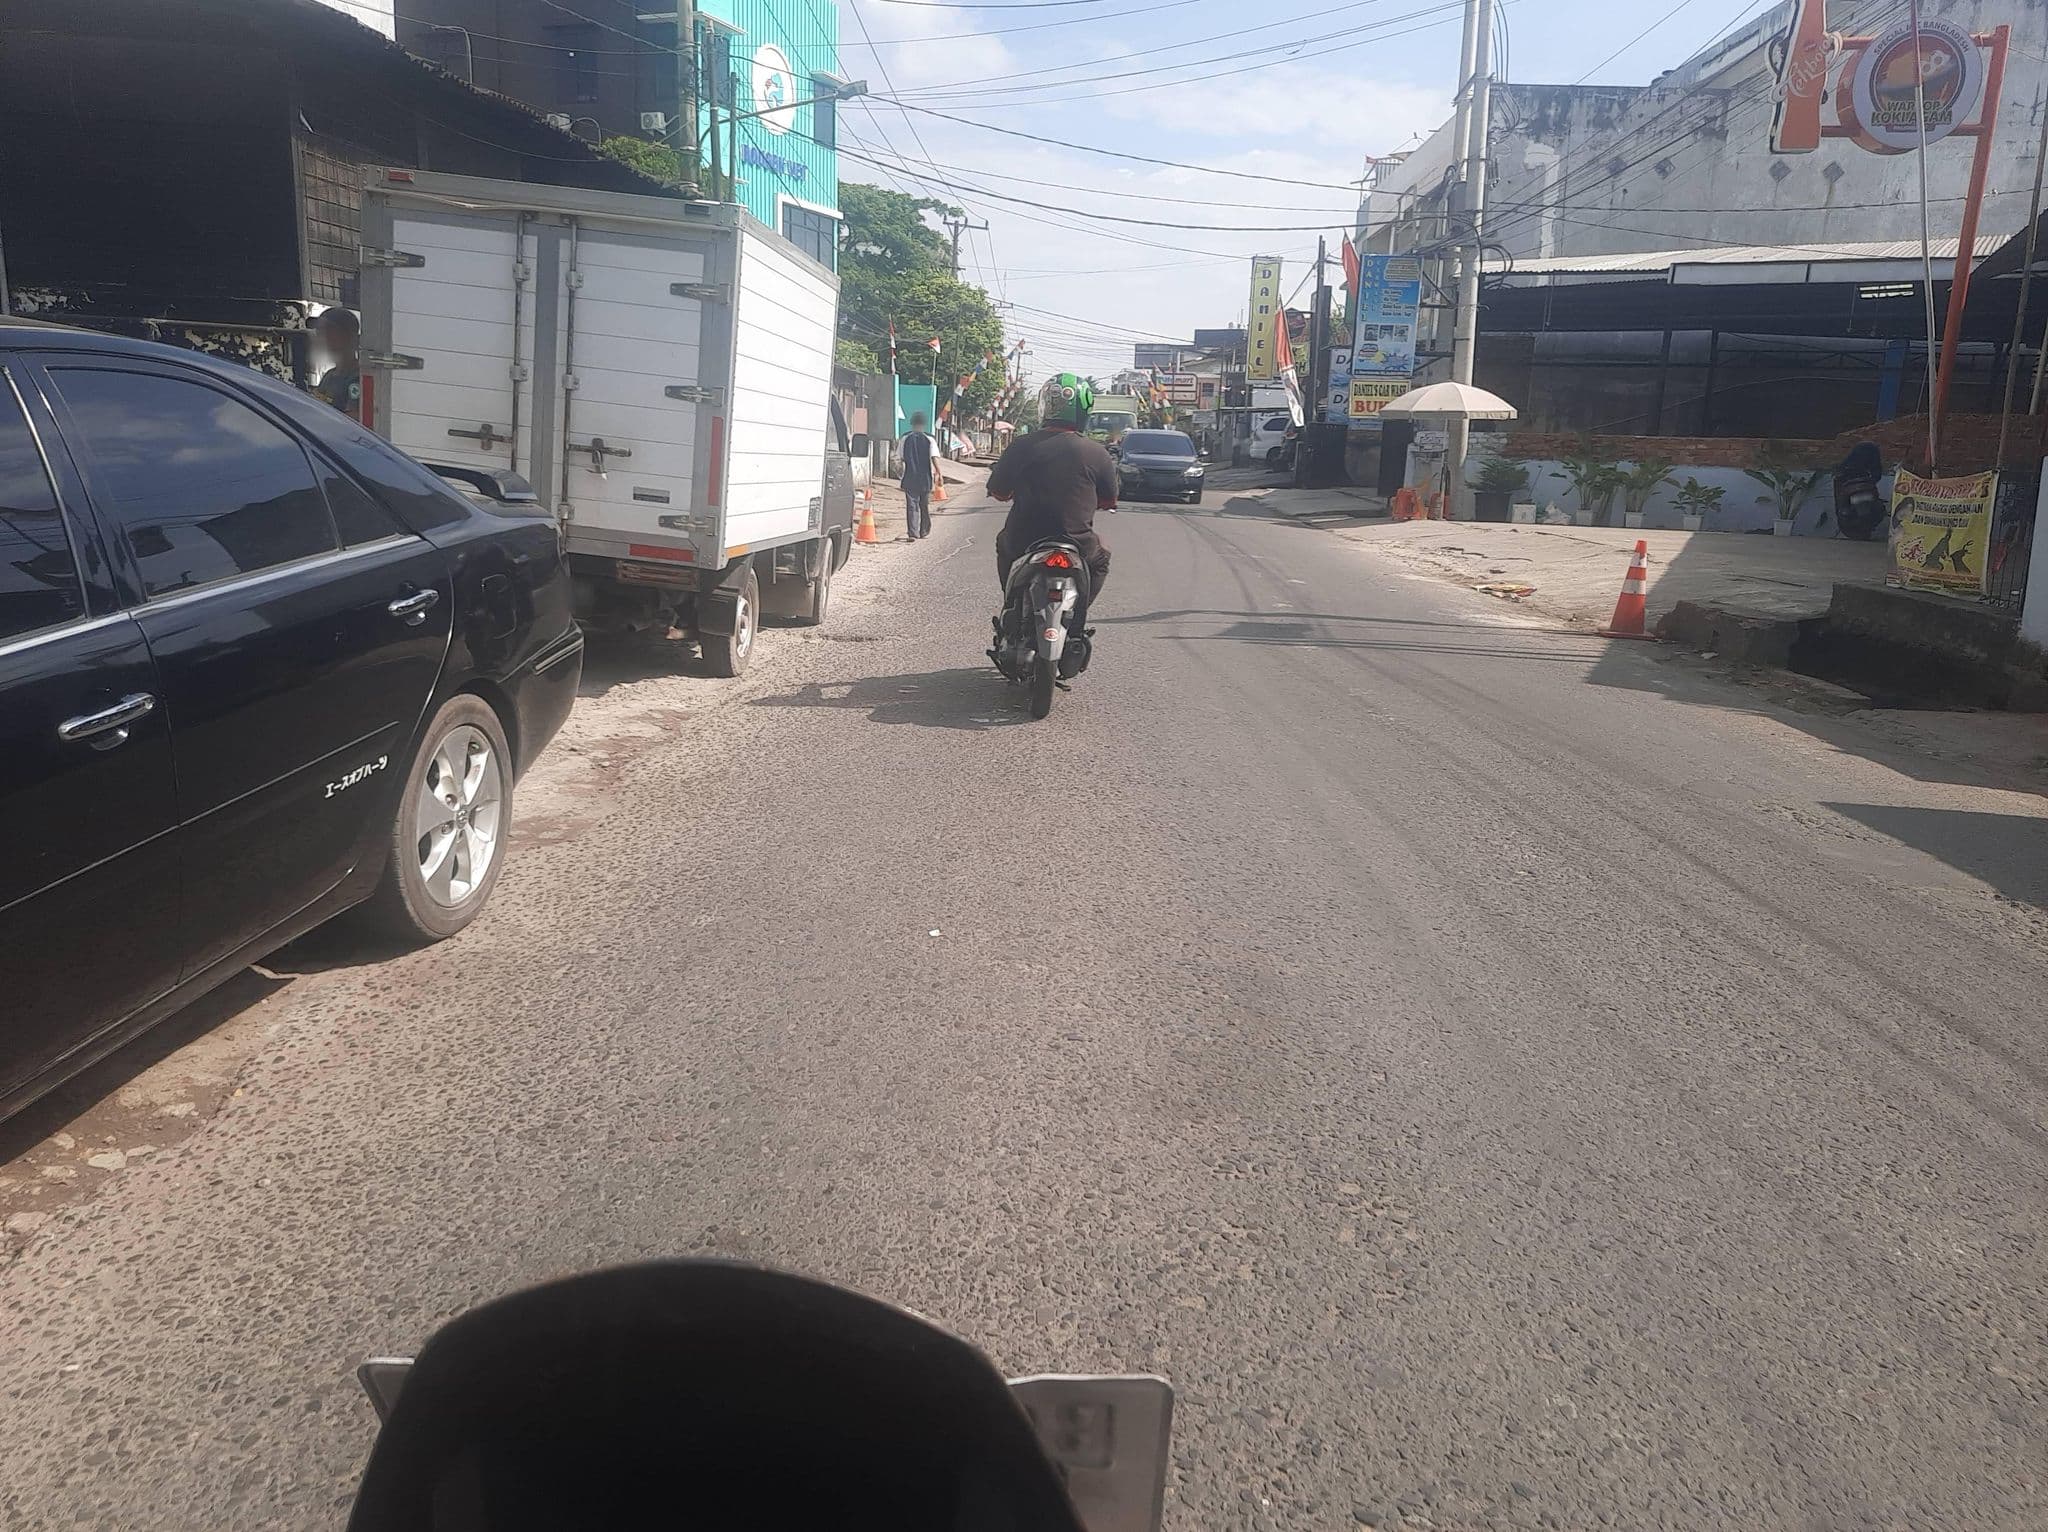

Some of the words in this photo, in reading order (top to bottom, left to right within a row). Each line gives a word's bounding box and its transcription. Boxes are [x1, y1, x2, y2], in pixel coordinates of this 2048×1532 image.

[1874, 26, 1904, 55] SPECIAL
[1923, 21, 1969, 53] BANGLADESH
[1887, 101, 1941, 111] WAROP
[1255, 269, 1272, 366] DANIEL
[1379, 384, 1390, 397] CAR
